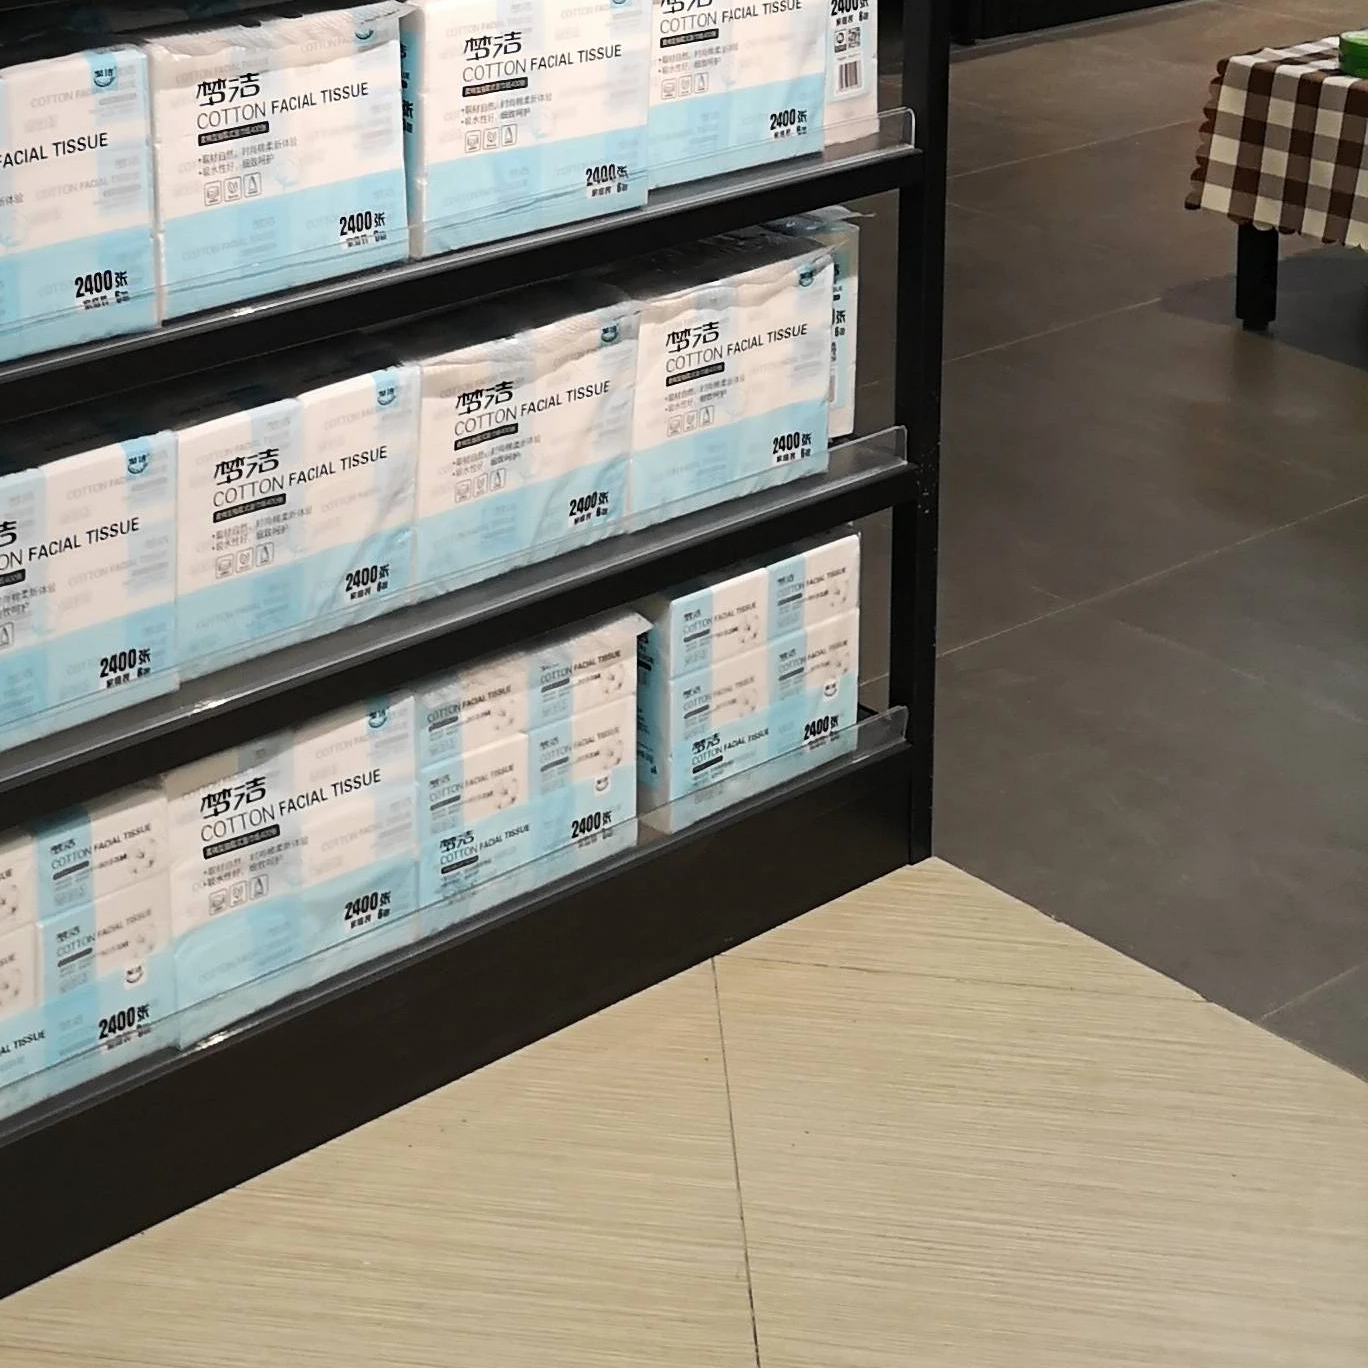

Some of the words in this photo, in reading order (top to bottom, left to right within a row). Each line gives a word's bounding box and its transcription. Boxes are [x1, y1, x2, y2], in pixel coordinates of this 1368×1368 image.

[661, 9, 718, 33] COTTON
[722, 6, 758, 23] FACIAL
[197, 73, 260, 106] 梦洁
[198, 104, 265, 129] COTTON
[272, 93, 316, 114] FACIAL
[321, 82, 368, 103] TISSUE
[770, 109, 807, 132] 2400张
[53, 133, 107, 156] TISSUE
[340, 211, 385, 236] 2400张
[75, 270, 128, 298] 2400张
[666, 322, 719, 353] 梦洁
[666, 345, 723, 371] COTTON
[727, 335, 763, 355] FACIAL
[768, 324, 807, 342] TISSUE
[773, 432, 811, 458] 2400张
[214, 449, 279, 485] 梦洁
[214, 476, 286, 507] COTTON
[289, 463, 335, 486] FACIAL
[340, 446, 387, 470] TISSUE
[29, 535, 81, 561] FACIAL
[86, 517, 138, 544] TISSUE
[346, 564, 389, 592] 2400张
[100, 649, 150, 678] 2400张
[201, 777, 267, 823] 梦洁
[201, 806, 280, 841] COTTON
[279, 788, 327, 816] FACIAL
[331, 769, 381, 796] TISSUE
[572, 811, 615, 843] 2400张
[441, 847, 473, 864] COTTON
[480, 836, 502, 850] FACIAL
[505, 824, 529, 838] TISSUE
[345, 892, 390, 922] 2400张
[99, 1004, 150, 1040] 2400张
[14, 1031, 45, 1049] TISSUE
